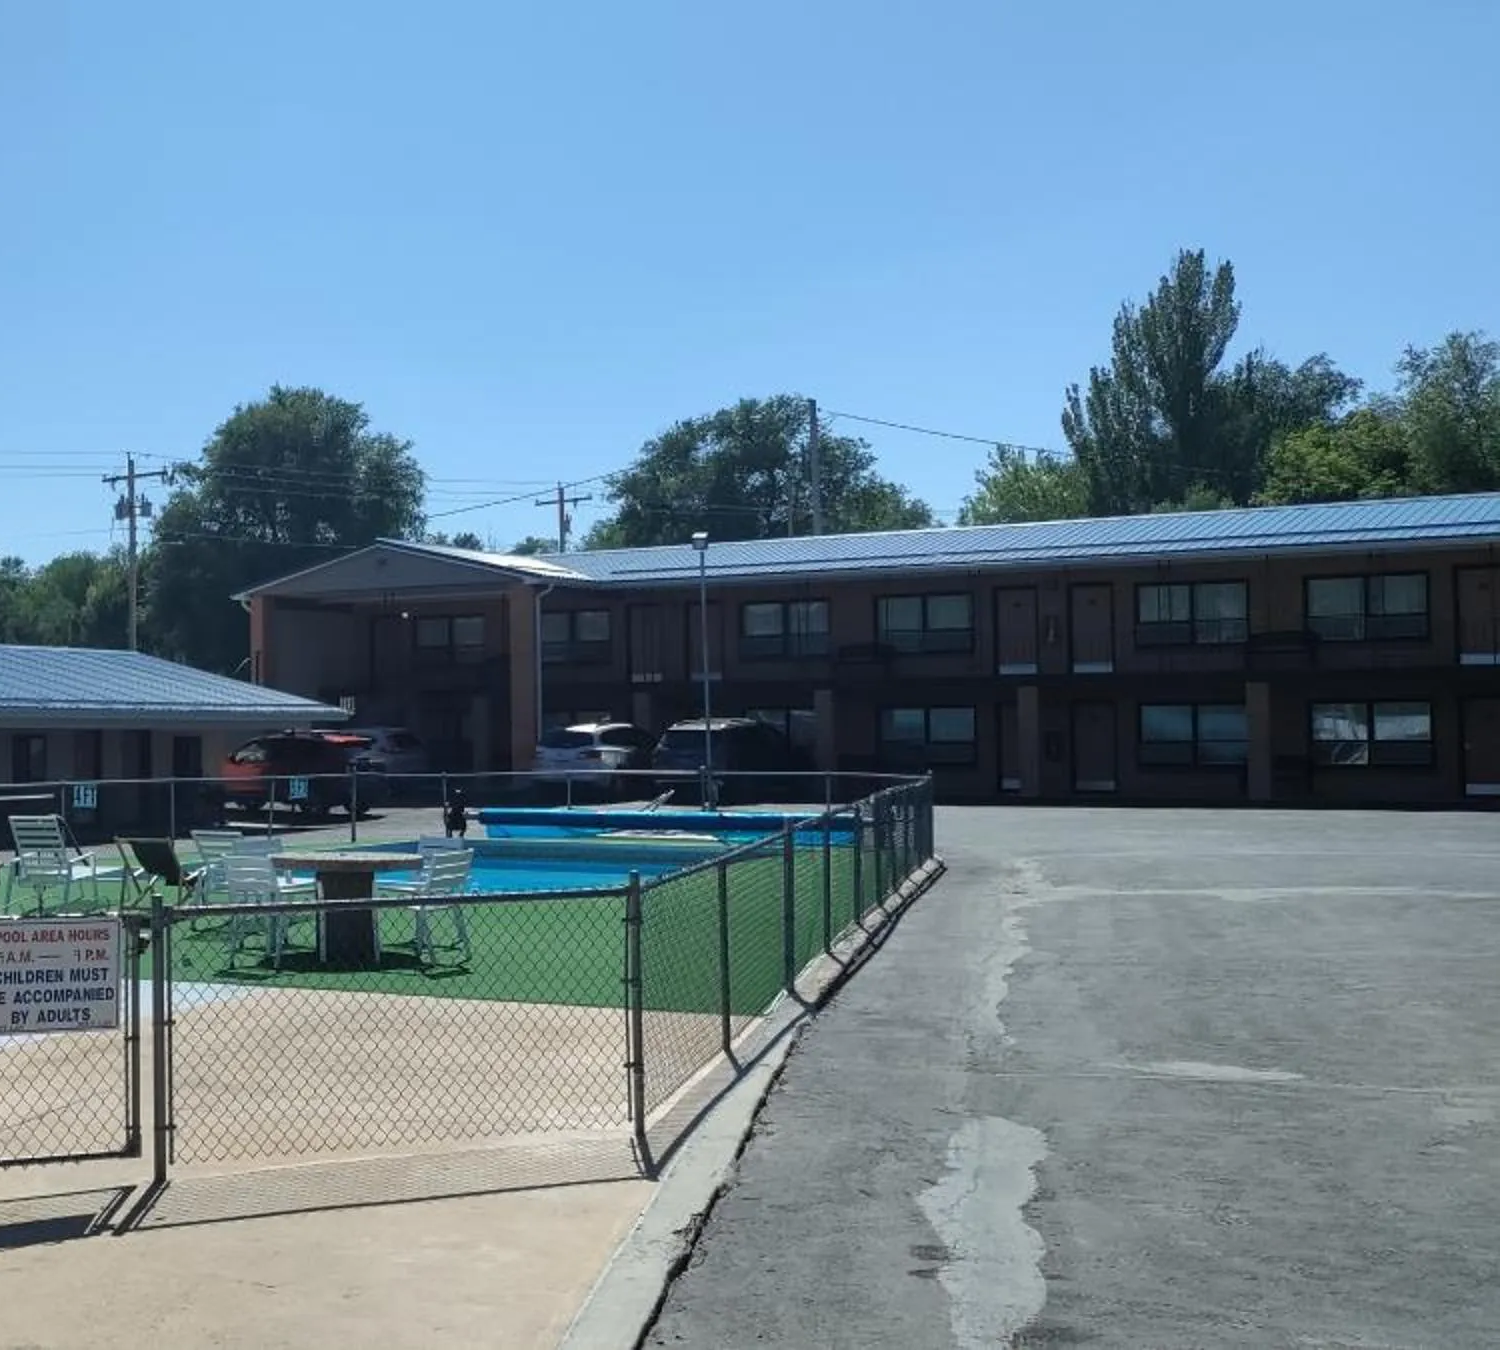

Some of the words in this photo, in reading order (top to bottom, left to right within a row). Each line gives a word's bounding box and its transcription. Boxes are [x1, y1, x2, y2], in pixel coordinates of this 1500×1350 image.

[32, 930, 64, 943] AREA
[70, 967, 109, 981] MUST
[13, 987, 115, 1004] ACCOMPANIED
[11, 1011, 29, 1025] BY
[37, 1007, 91, 1022] ADULTS
